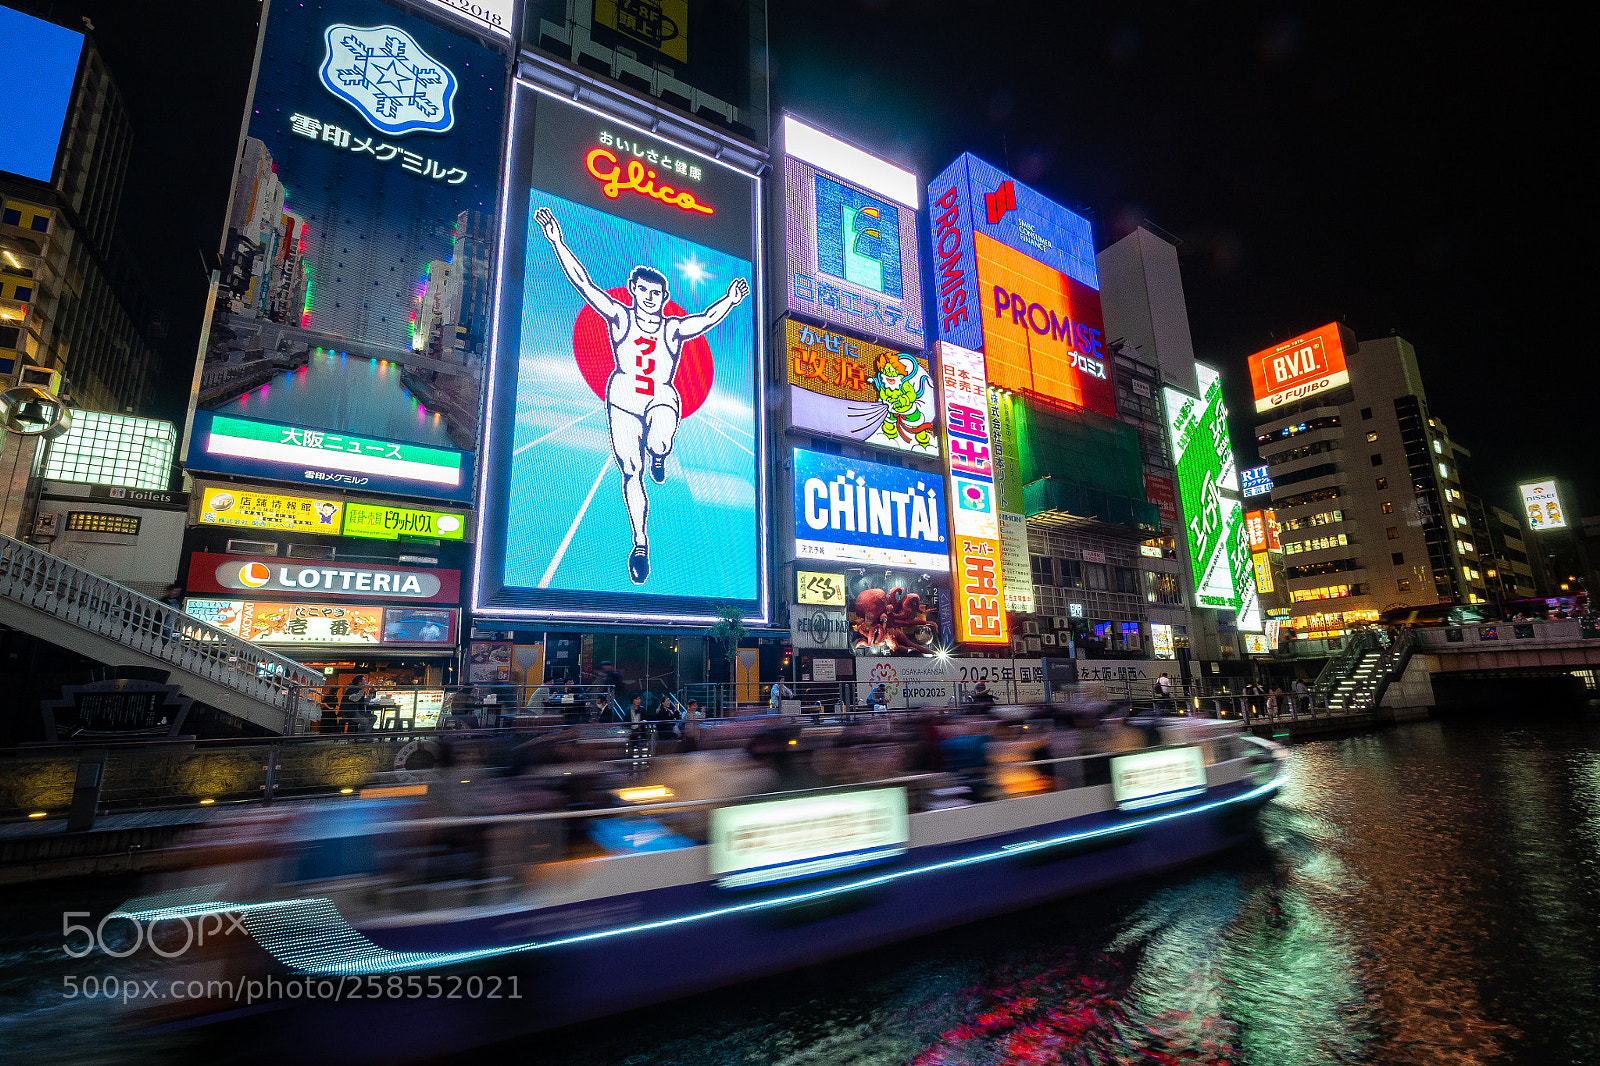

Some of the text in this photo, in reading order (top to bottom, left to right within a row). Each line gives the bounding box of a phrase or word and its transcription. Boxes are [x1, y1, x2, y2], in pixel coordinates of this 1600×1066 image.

[460, 0, 501, 26] 2018
[290, 112, 467, 184] 雪印メグミルク
[599, 131, 702, 181] おいしさと健康
[586, 148, 714, 214] Glico
[1018, 226, 1053, 249] CONSUMER
[1019, 233, 1047, 252] FINANCE
[934, 186, 968, 332] PROMISE
[794, 273, 924, 335] 日商エステム
[993, 284, 1104, 359] PROMISE
[798, 326, 860, 358] かぜに
[633, 337, 656, 396] グリコ
[793, 347, 867, 391] 改源
[944, 364, 984, 382] 日本一
[1067, 351, 1107, 380] プロミス
[1273, 346, 1321, 383] B.V.D.
[1285, 379, 1330, 400] FUJIBO
[280, 427, 403, 460] 大阪ニュース
[948, 402, 993, 484] 玉出
[990, 393, 1008, 509] 株式会社日本リート
[304, 470, 369, 486] 雪印メグミルク
[129, 490, 171, 502] Toilets
[240, 496, 312, 512] 店舗情報館
[384, 510, 432, 533] ピタットハウス
[1190, 469, 1221, 562] エイブル
[963, 541, 994, 555] スーパー
[279, 567, 422, 593] LOTTERIA
[188, 601, 231, 609] KOREAN
[964, 555, 1002, 638] 玉出
[1076, 666, 1147, 681] を大阪・関西へ
